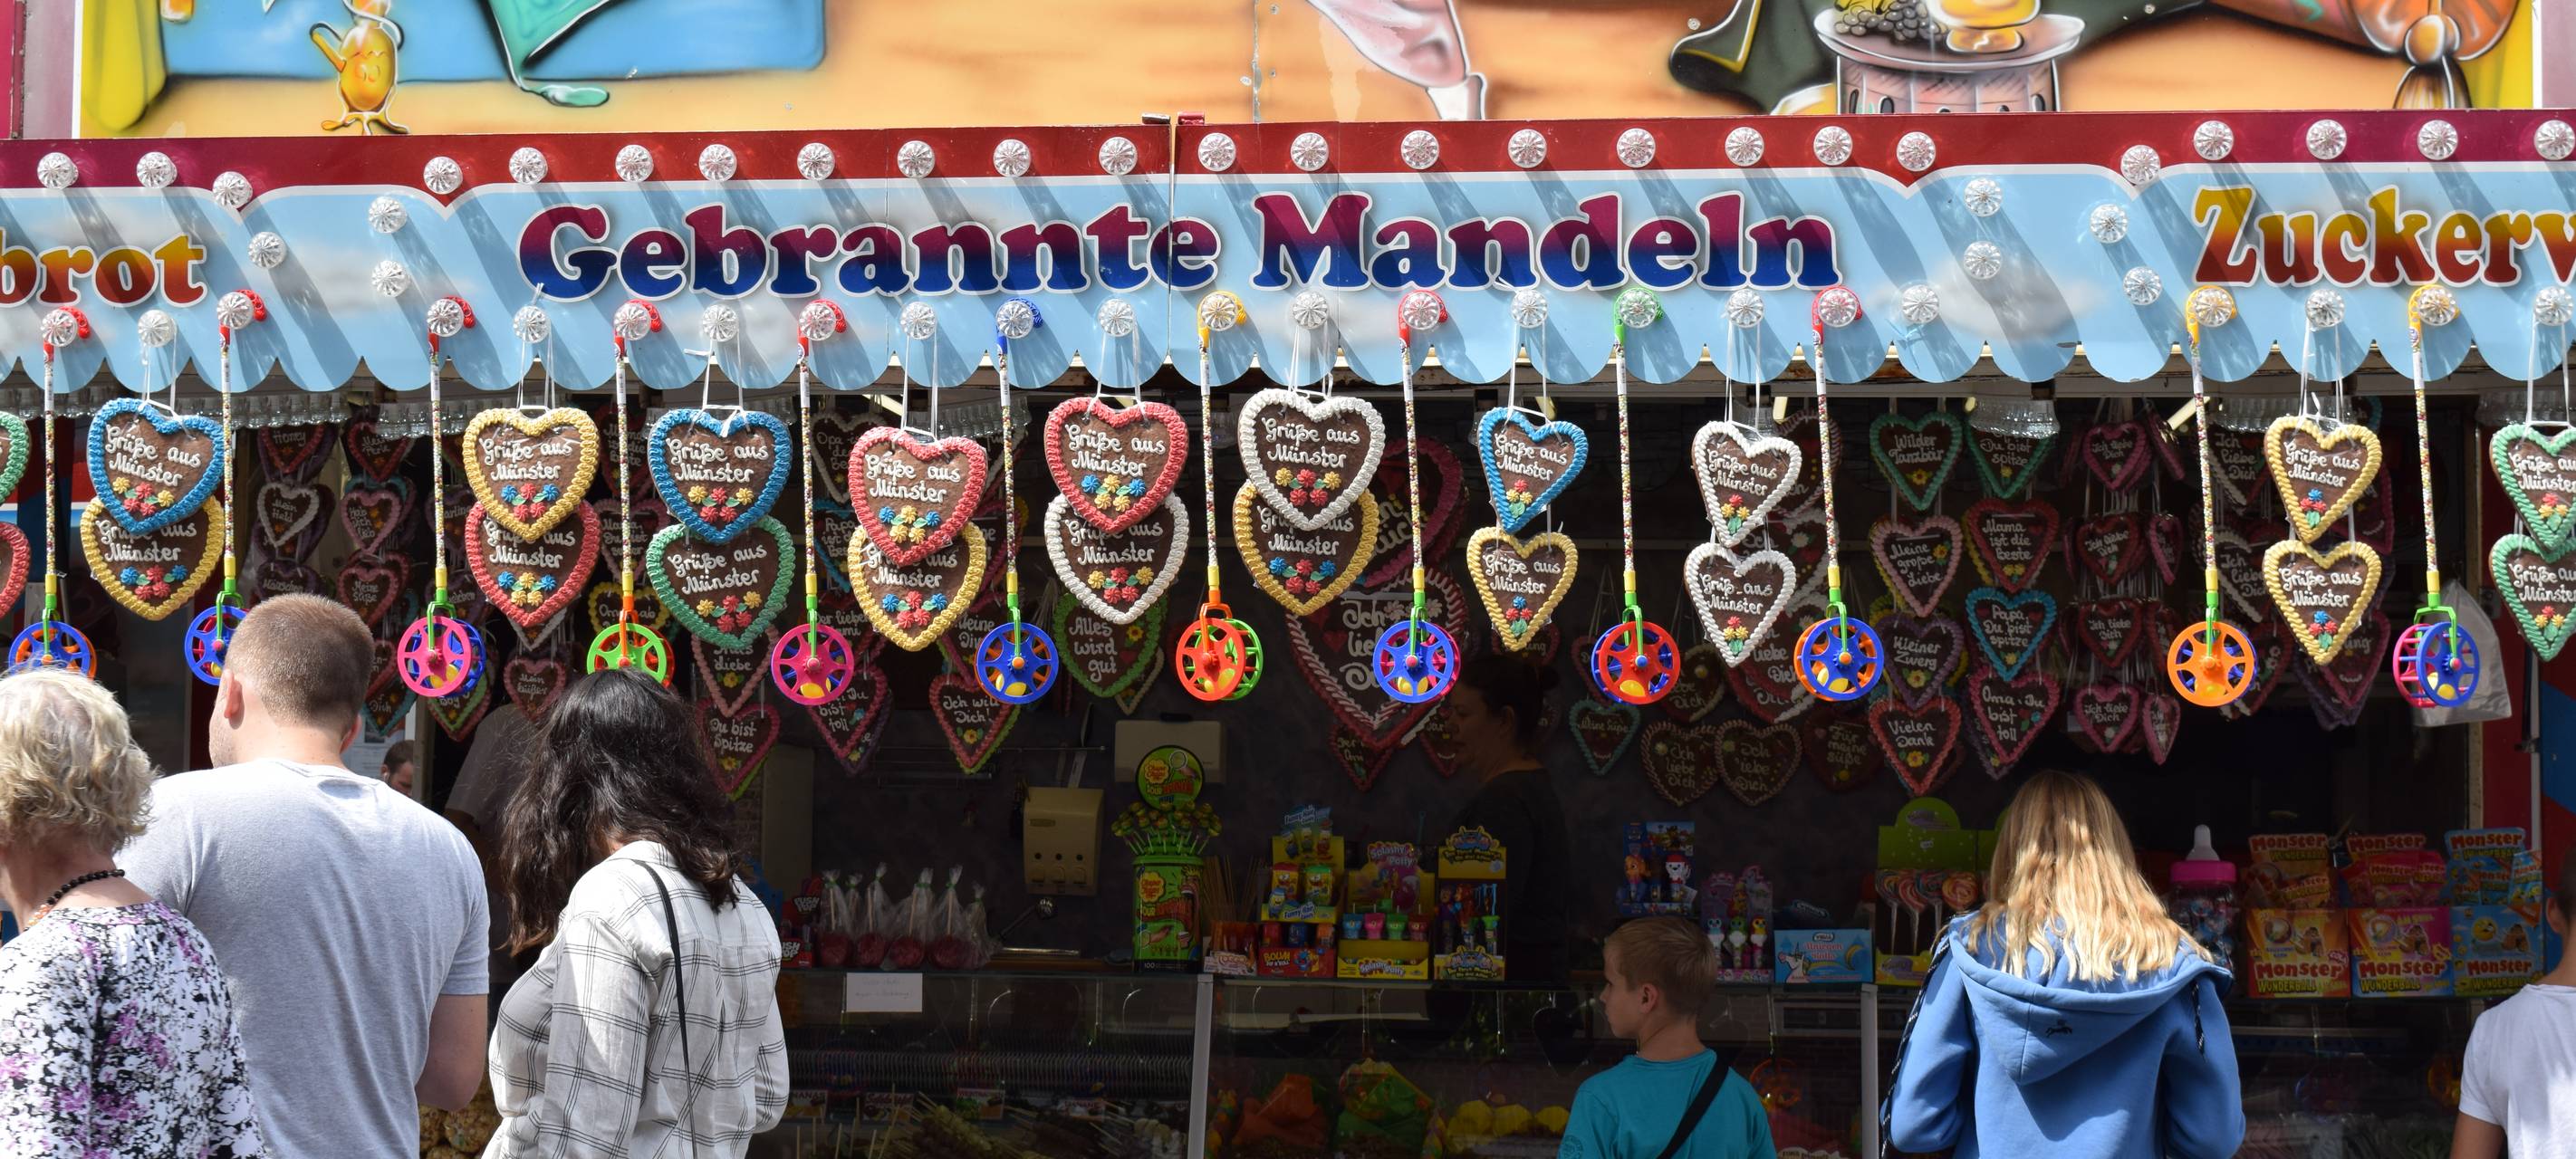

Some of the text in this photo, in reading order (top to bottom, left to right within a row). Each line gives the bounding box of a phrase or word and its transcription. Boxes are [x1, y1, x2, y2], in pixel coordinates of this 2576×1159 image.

[516, 190, 1843, 302] Gebrannte Mandeln
[1065, 424, 1166, 454] Grüße aus
[1262, 417, 1360, 445] Grüße aus
[106, 424, 201, 468] Grüße aus
[479, 437, 572, 466] Grüße aus
[665, 437, 769, 465] Grüße aus
[1495, 433, 1567, 465] Grüße aus
[1892, 435, 1937, 450] Wilder
[1072, 451, 1146, 477] Münster
[1267, 444, 1346, 468] Münster
[1707, 449, 1777, 480] Grüße aus
[2283, 441, 2360, 471] Grüße aus
[2509, 453, 2556, 478] Grüße
[110, 453, 182, 486] Münster
[491, 464, 562, 482] Münster
[675, 463, 754, 482] Münster
[865, 453, 916, 481] Grüße
[928, 465, 961, 483] aus
[1496, 455, 1552, 481] Münster
[2288, 467, 2347, 487] Münster
[870, 478, 947, 503] Münster
[1712, 472, 1768, 496] Münster
[1982, 519, 2026, 534] Mama
[1268, 533, 1339, 556] Münster
[1989, 532, 2033, 547] ist die
[105, 541, 181, 561] Münster
[489, 546, 563, 569] Münster
[668, 544, 767, 578] Grüße aus
[1078, 542, 1155, 565] Münster
[1890, 543, 1929, 560] Meine
[1483, 552, 1562, 578] Grüße aus
[1897, 553, 1935, 574] große
[682, 570, 761, 595] Münster
[872, 567, 943, 588] Münster
[1490, 575, 1547, 594] Münster
[1908, 572, 1944, 587] Liebe
[2279, 567, 2362, 590] Grüße aus
[2509, 563, 2557, 588] Grüße
[1744, 582, 1773, 596] aus
[2240, 584, 2264, 598] Dic
[2290, 590, 2350, 608] Münster
[2519, 585, 2576, 602] Münste
[1341, 599, 1386, 629] Ich
[1705, 595, 1764, 615] Münster
[1069, 617, 1113, 637] Alles
[1983, 619, 2033, 636] Du bist
[1074, 637, 1118, 656] wird
[1893, 637, 1941, 655] Kleiner
[1088, 656, 1117, 682] gut
[1894, 650, 1937, 671] Zwerg
[942, 695, 966, 710] Ich
[2024, 694, 2045, 708] Du
[1987, 707, 2018, 724] bist
[731, 722, 757, 737] bist
[1888, 720, 1936, 735] Vielen
[1996, 726, 2018, 742] toll
[1896, 732, 1935, 747] Dank
[2255, 963, 2342, 978] Monster
[2359, 962, 2445, 977] Monster
[2467, 960, 2533, 976] Monster
